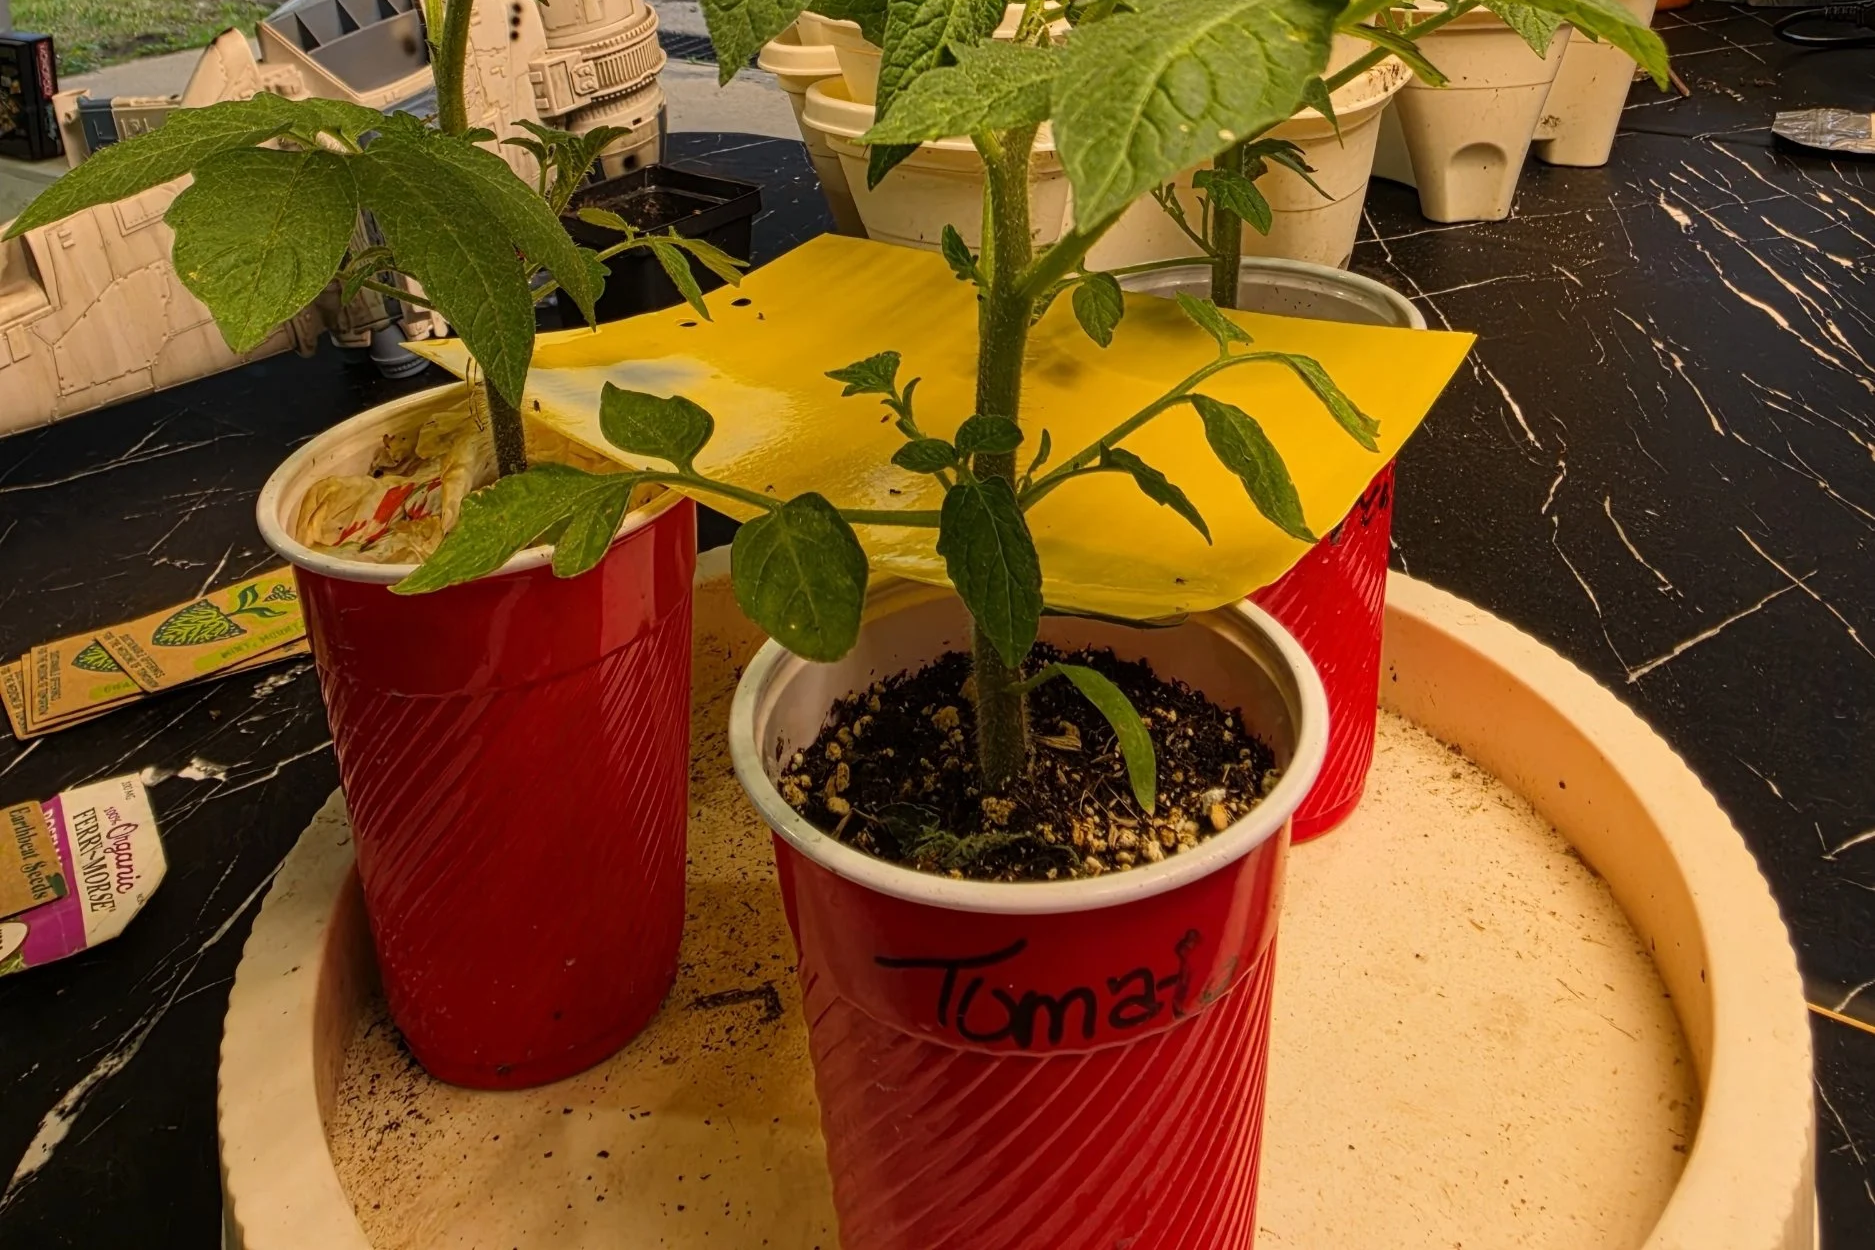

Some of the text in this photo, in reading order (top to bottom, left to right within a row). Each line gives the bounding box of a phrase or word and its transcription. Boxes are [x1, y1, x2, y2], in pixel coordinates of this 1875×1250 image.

[9, 806, 53, 901] Earthbeat Seeds
[103, 806, 139, 894] 100% Organic
